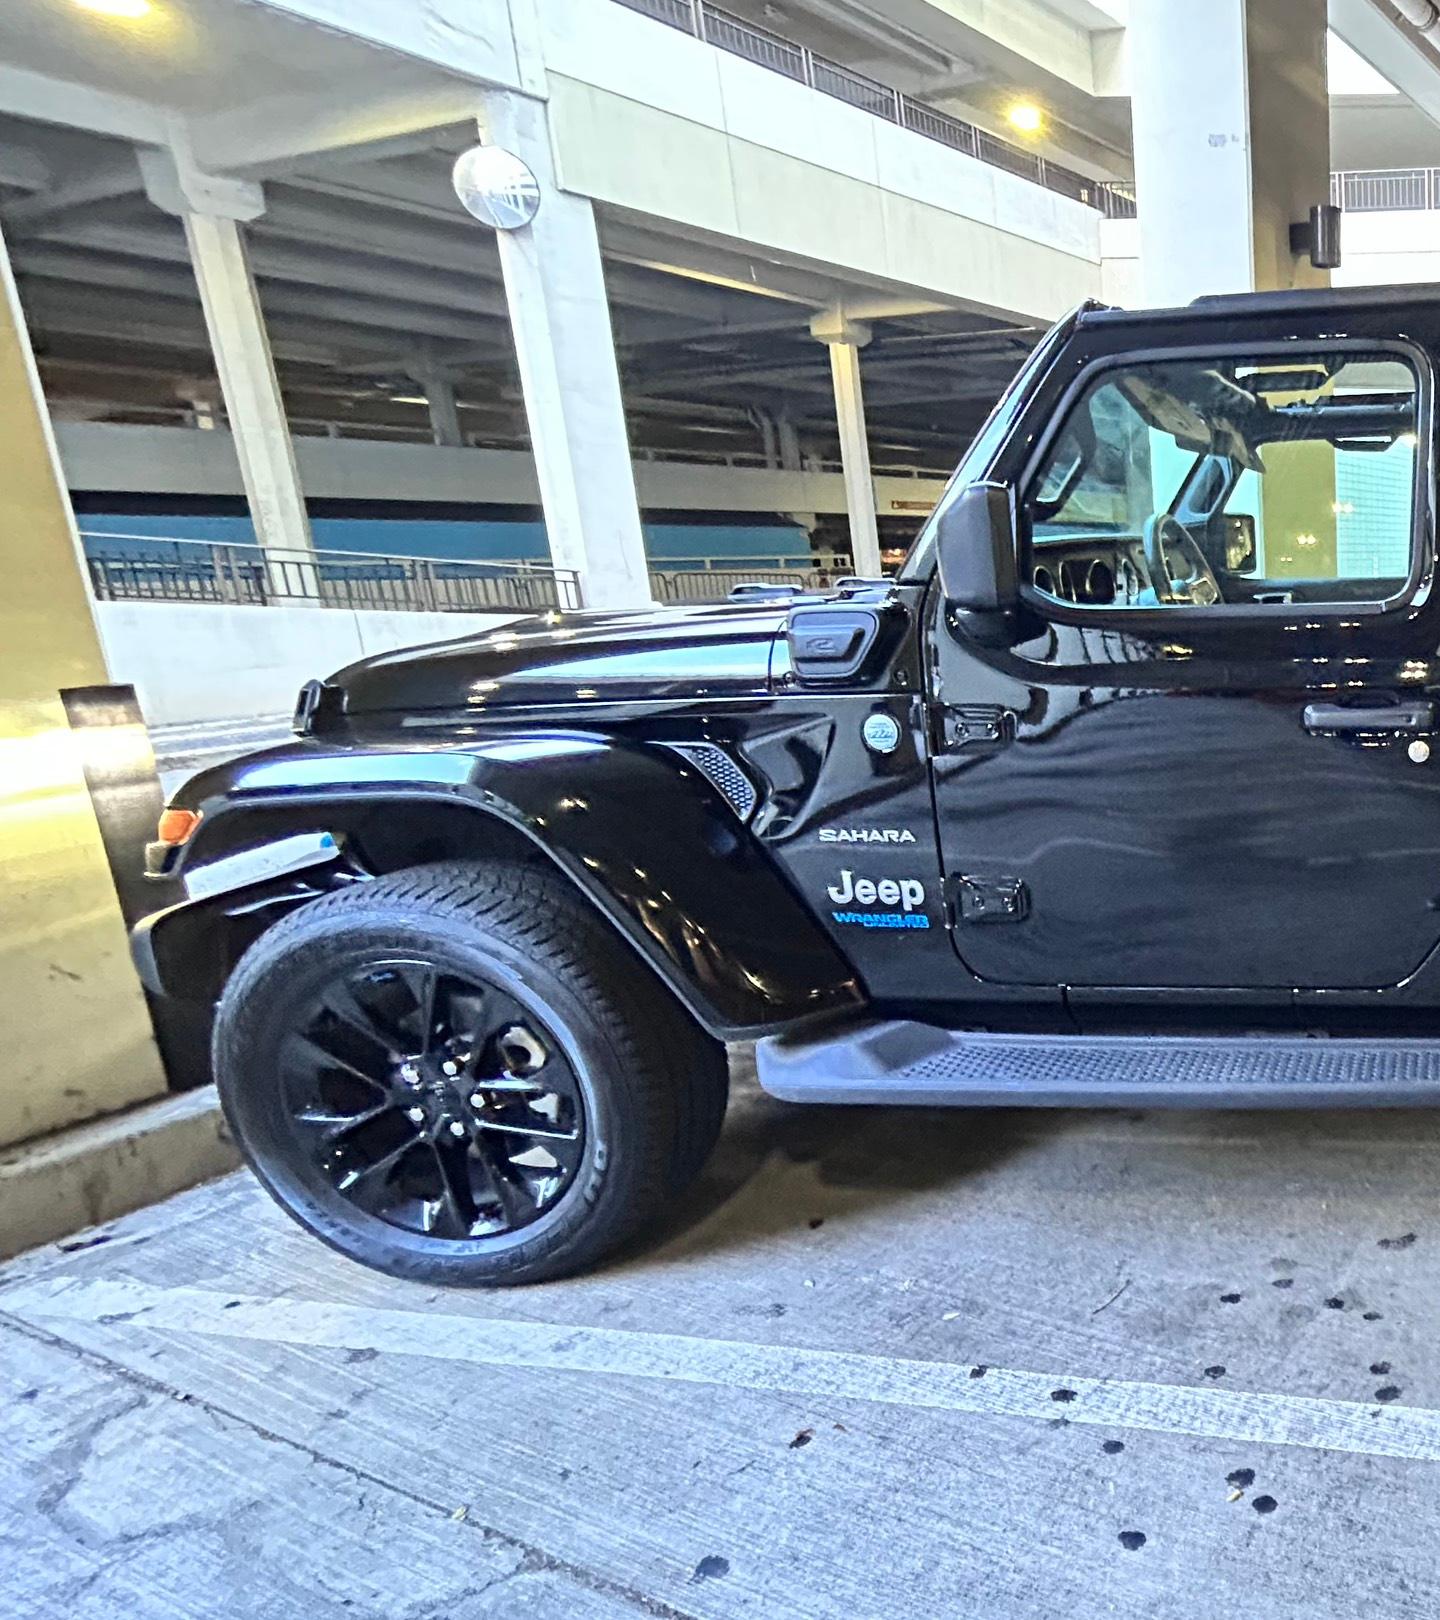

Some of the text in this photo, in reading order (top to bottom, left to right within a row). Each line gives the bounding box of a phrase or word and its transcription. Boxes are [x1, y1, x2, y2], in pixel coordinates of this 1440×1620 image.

[819, 829, 916, 842] SAHARA
[827, 870, 925, 912] Jeep
[832, 912, 928, 923] WRANGLER
